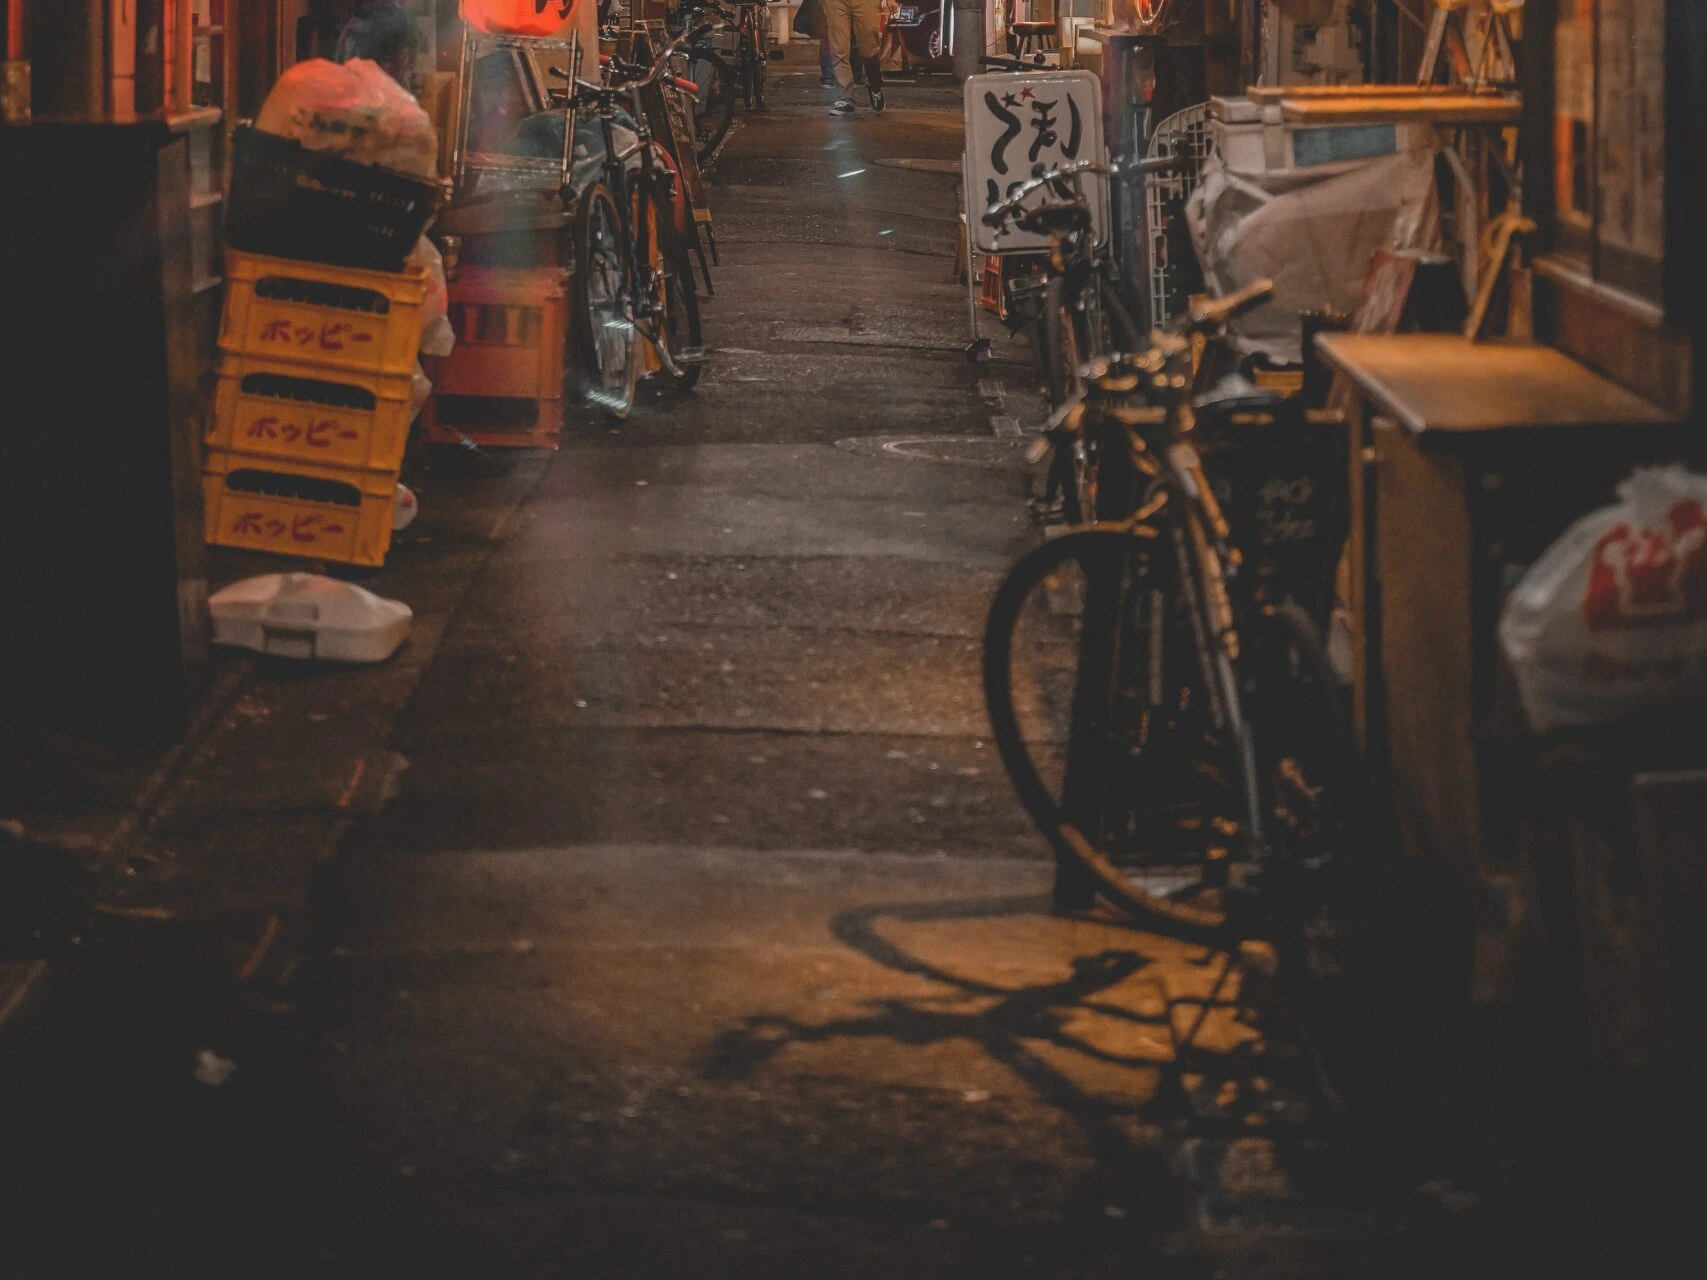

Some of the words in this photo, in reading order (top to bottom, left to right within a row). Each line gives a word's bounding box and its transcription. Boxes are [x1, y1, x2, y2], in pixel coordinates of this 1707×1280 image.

[261, 319, 372, 351] ホッピー
[247, 416, 359, 448] ホッピー
[231, 512, 344, 543] ホッピー
